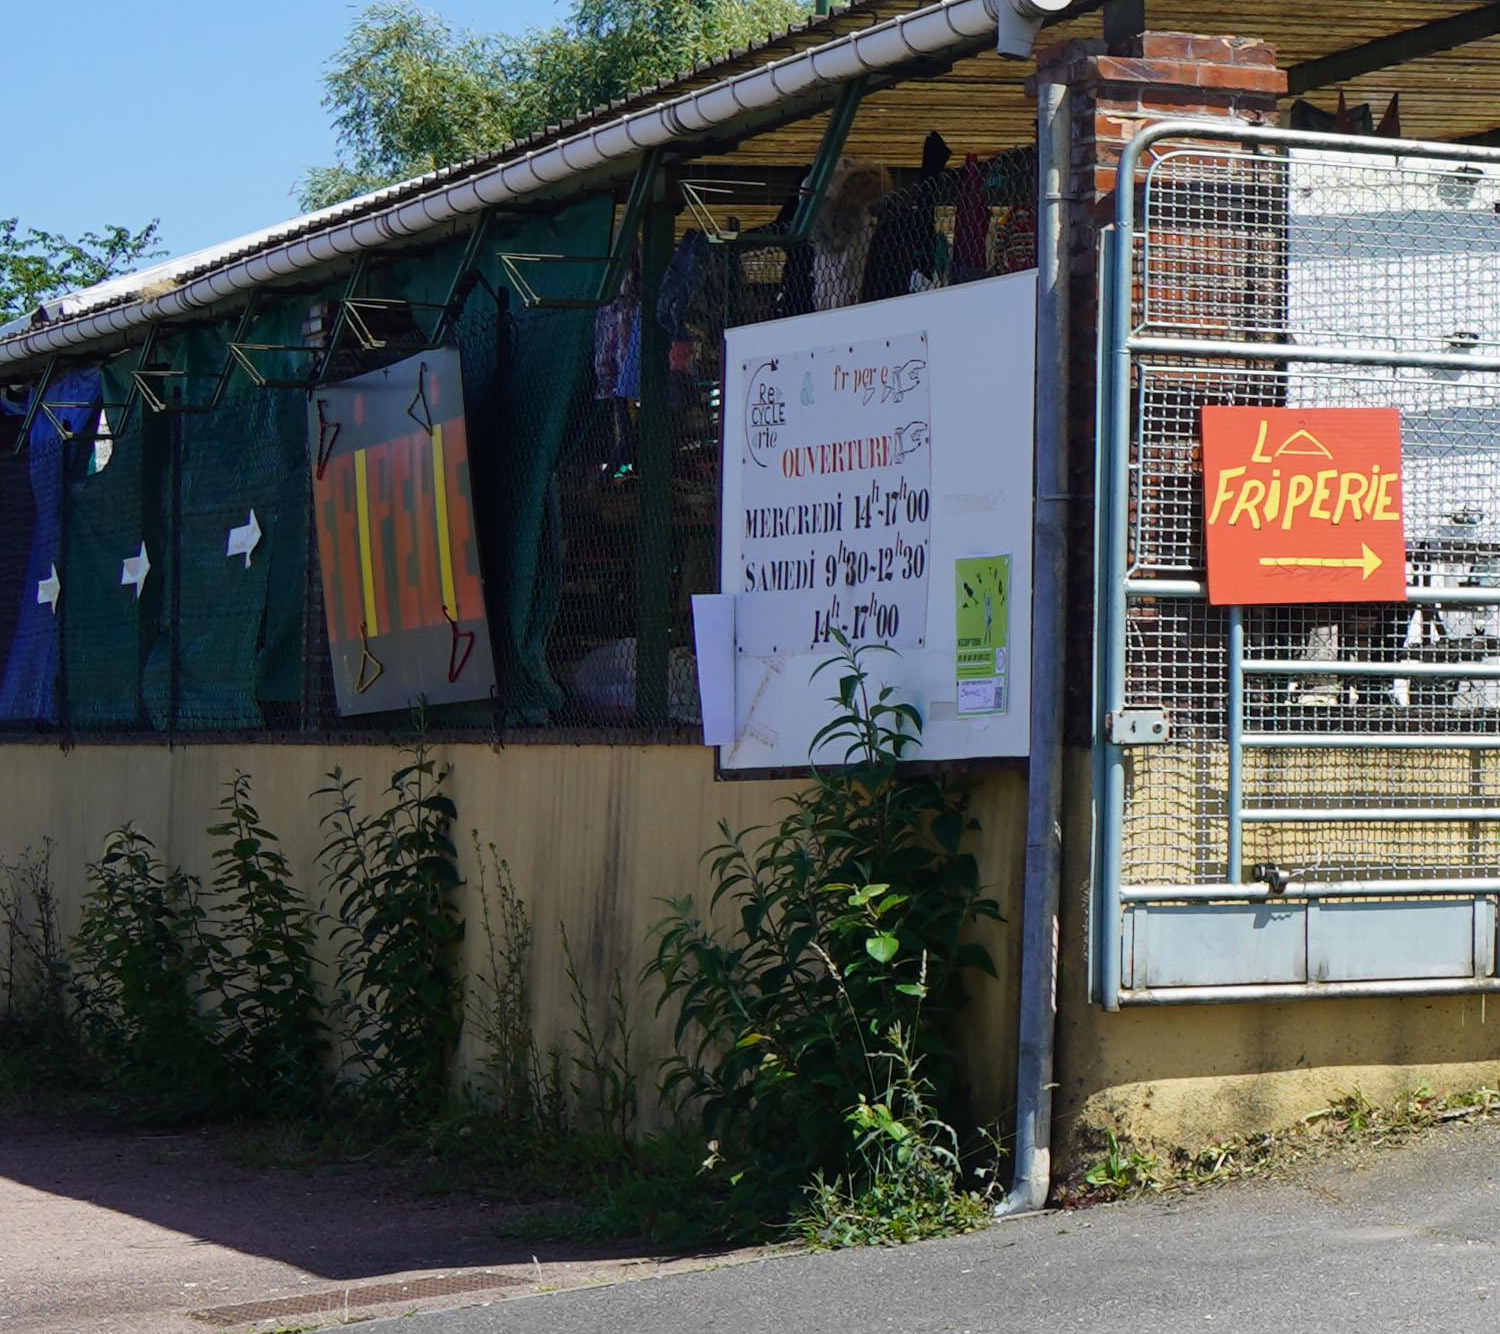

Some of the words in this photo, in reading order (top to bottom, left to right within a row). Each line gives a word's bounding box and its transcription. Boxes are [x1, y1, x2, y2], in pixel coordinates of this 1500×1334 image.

[751, 402, 785, 426] CYCLE
[781, 435, 893, 479] OUVERTURE
[1252, 419, 1334, 463] LA
[745, 492, 843, 539] MERCREDI
[745, 549, 816, 593] SAMEDI
